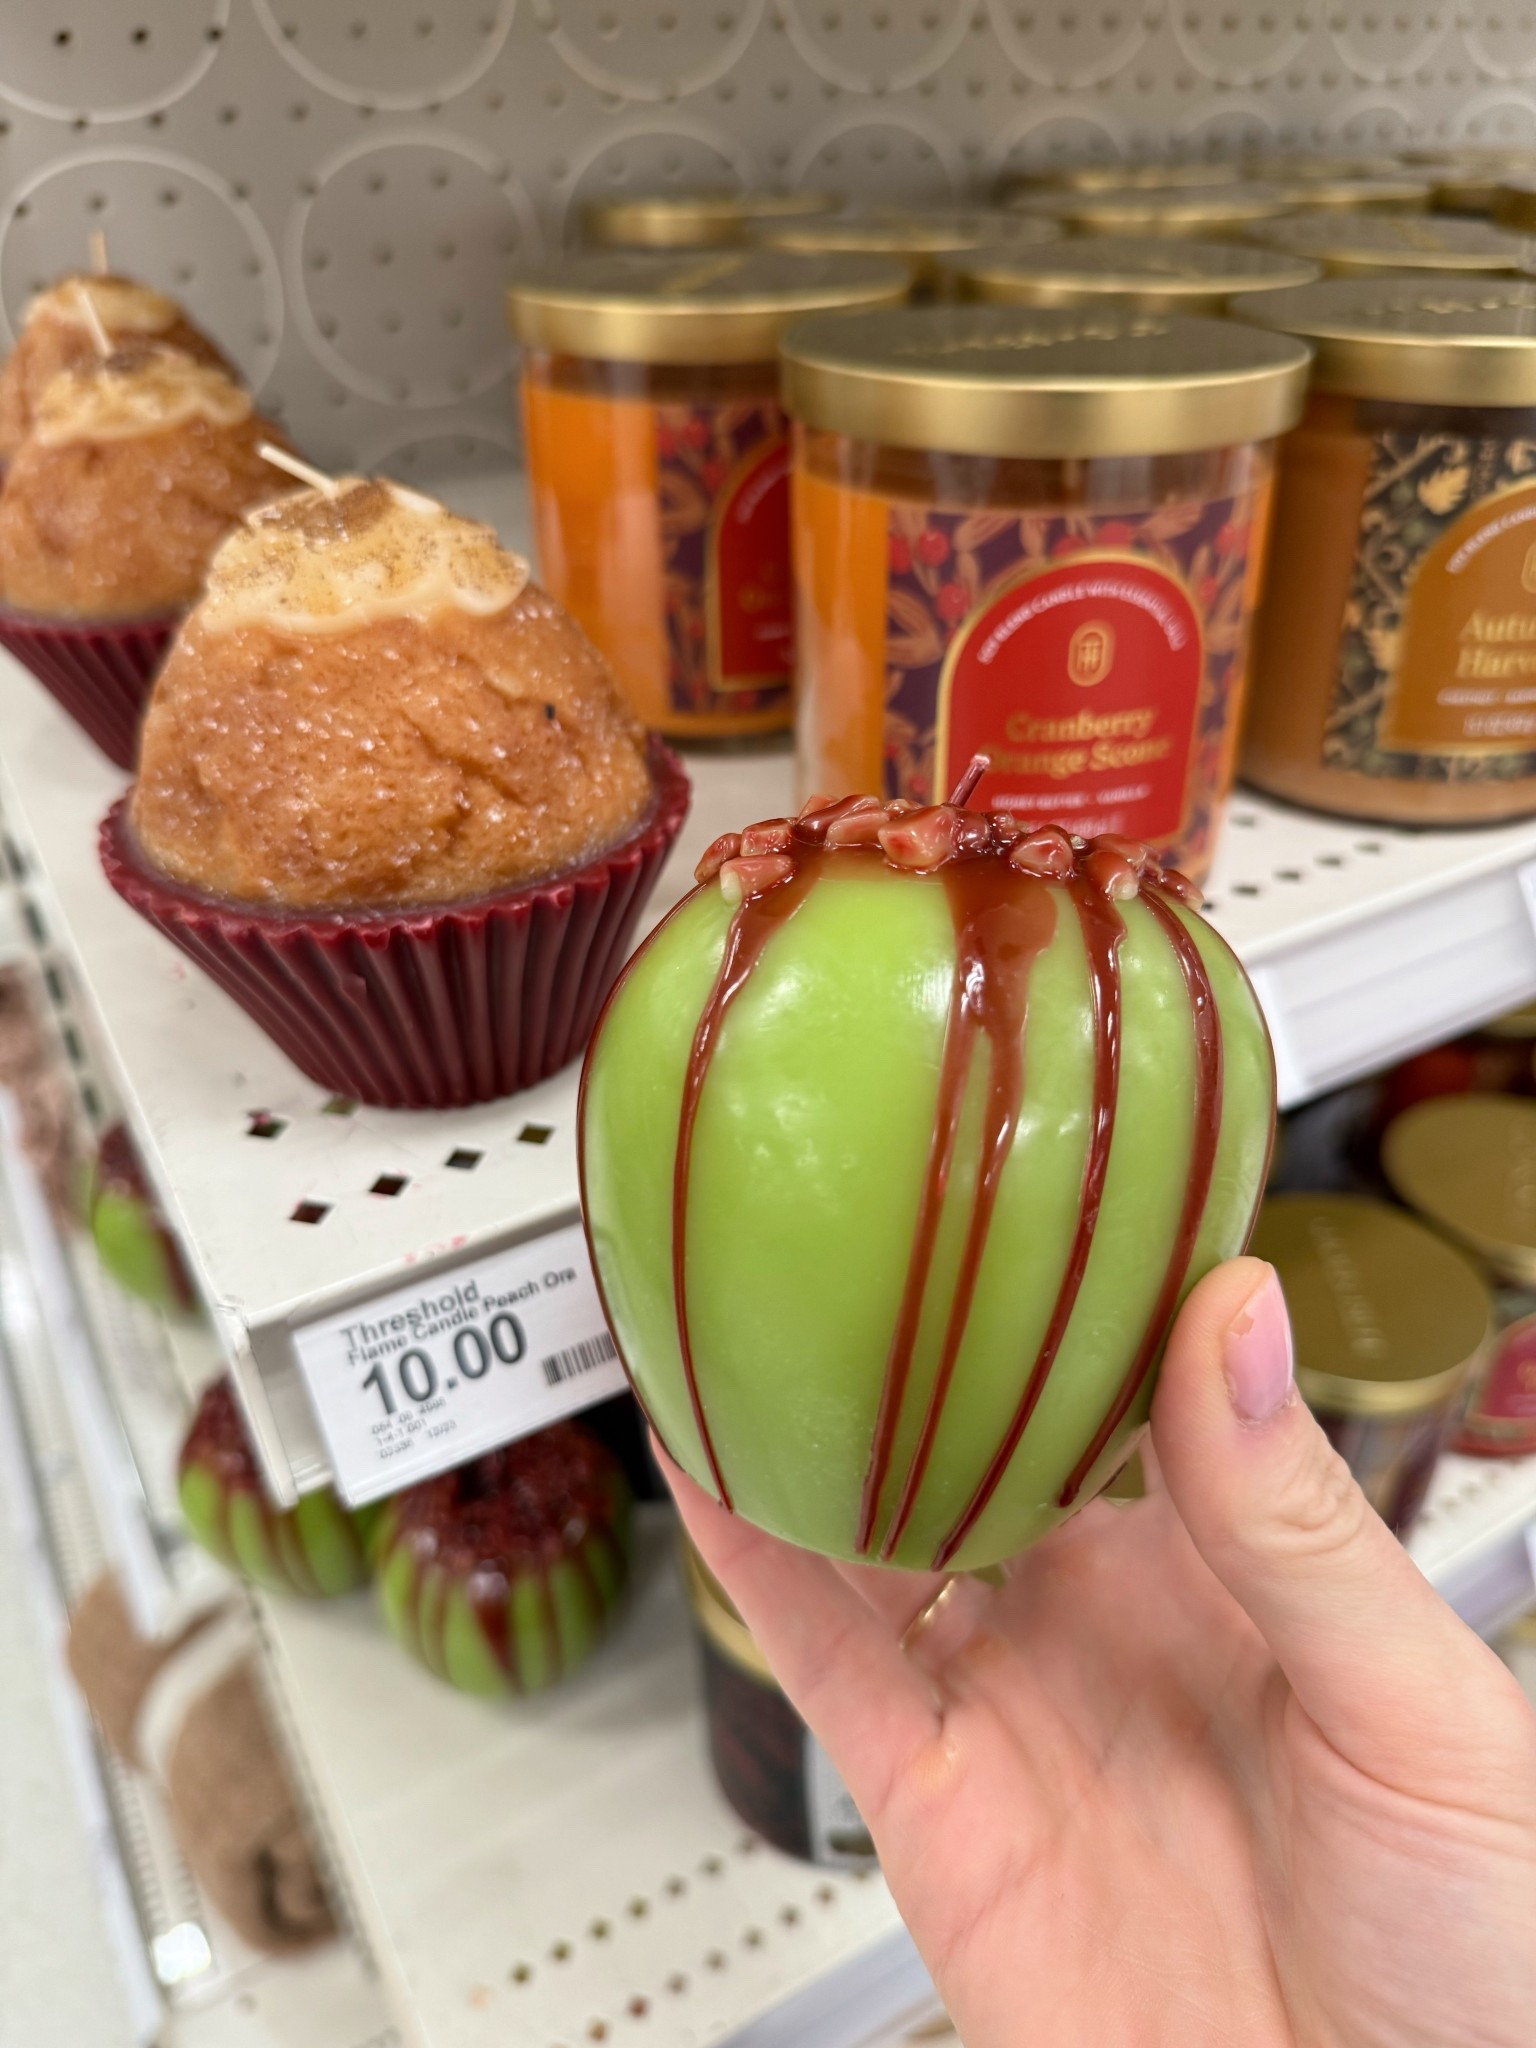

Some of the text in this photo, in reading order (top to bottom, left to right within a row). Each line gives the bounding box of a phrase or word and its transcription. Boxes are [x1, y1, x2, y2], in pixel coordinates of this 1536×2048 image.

[1005, 708, 1157, 742] Cranberry
[1090, 735, 1174, 771] Scone
[341, 1279, 480, 1350] Threshold
[347, 1335, 408, 1366] Flame
[413, 1307, 479, 1341] Candle
[482, 1282, 540, 1313] Peach
[361, 1310, 527, 1415] 10.00
